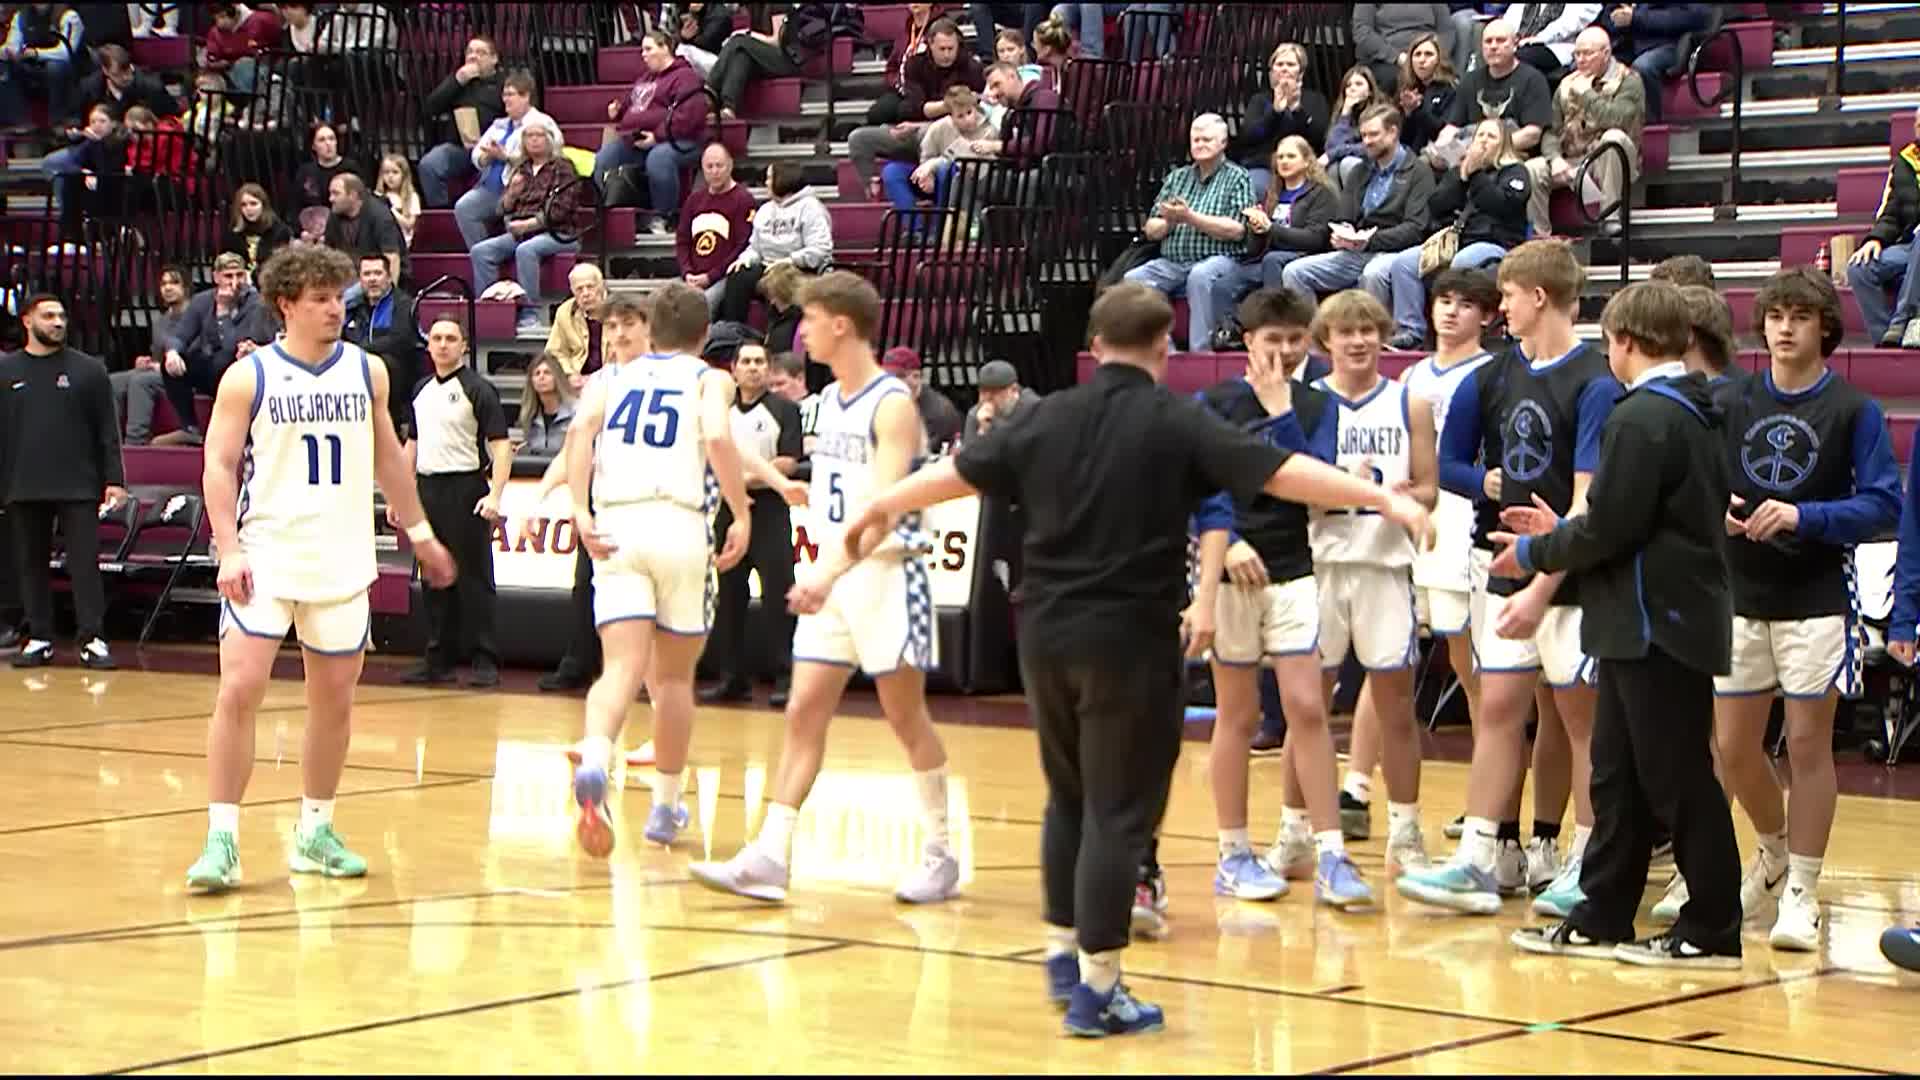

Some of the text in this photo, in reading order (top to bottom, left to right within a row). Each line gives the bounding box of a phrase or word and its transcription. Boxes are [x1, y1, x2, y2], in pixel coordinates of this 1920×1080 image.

[269, 392, 366, 425] BLUEJACKETS
[607, 388, 684, 448] 45
[301, 433, 342, 486] 11
[828, 471, 845, 523] 5
